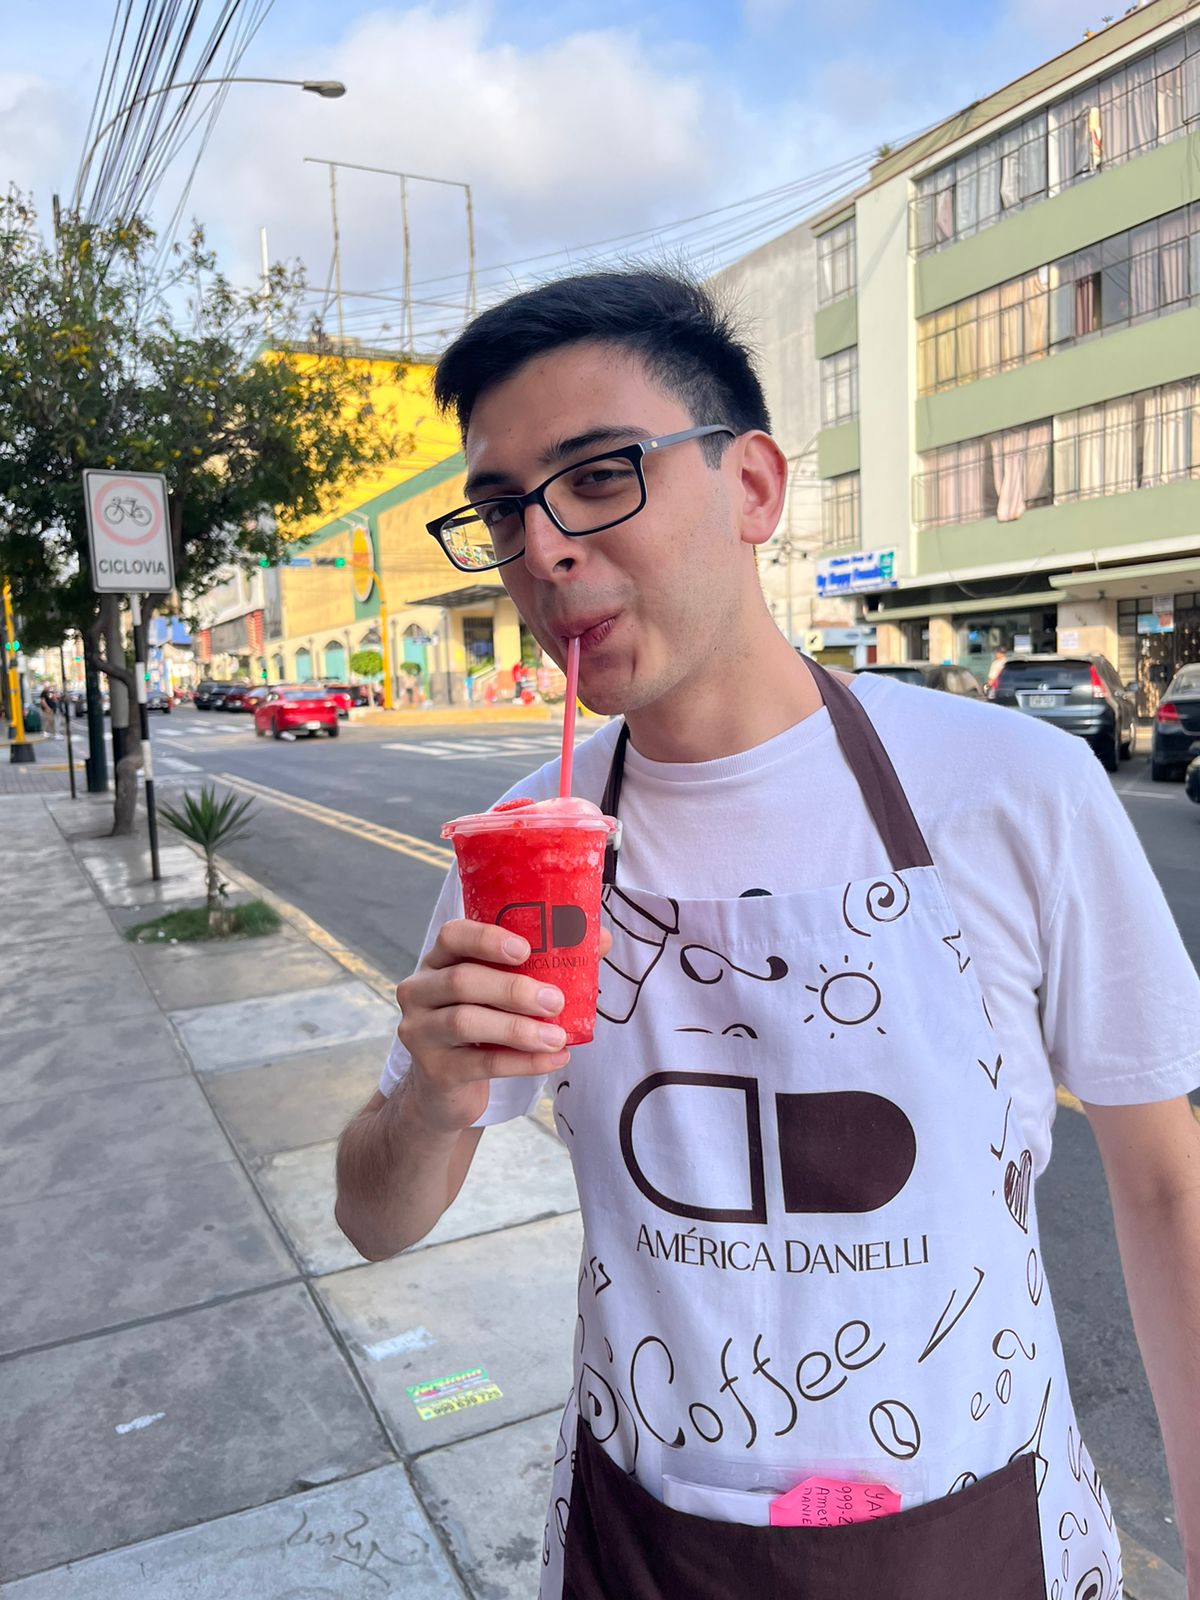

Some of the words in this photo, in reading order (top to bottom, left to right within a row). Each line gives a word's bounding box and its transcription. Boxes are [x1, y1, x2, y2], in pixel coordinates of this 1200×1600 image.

[98, 559, 167, 575] CICLOVIA
[523, 957, 550, 970] RICA
[636, 1223, 777, 1273] AMÉRICA
[784, 1234, 930, 1275] DANIELLI
[630, 1319, 887, 1449] Coffee
